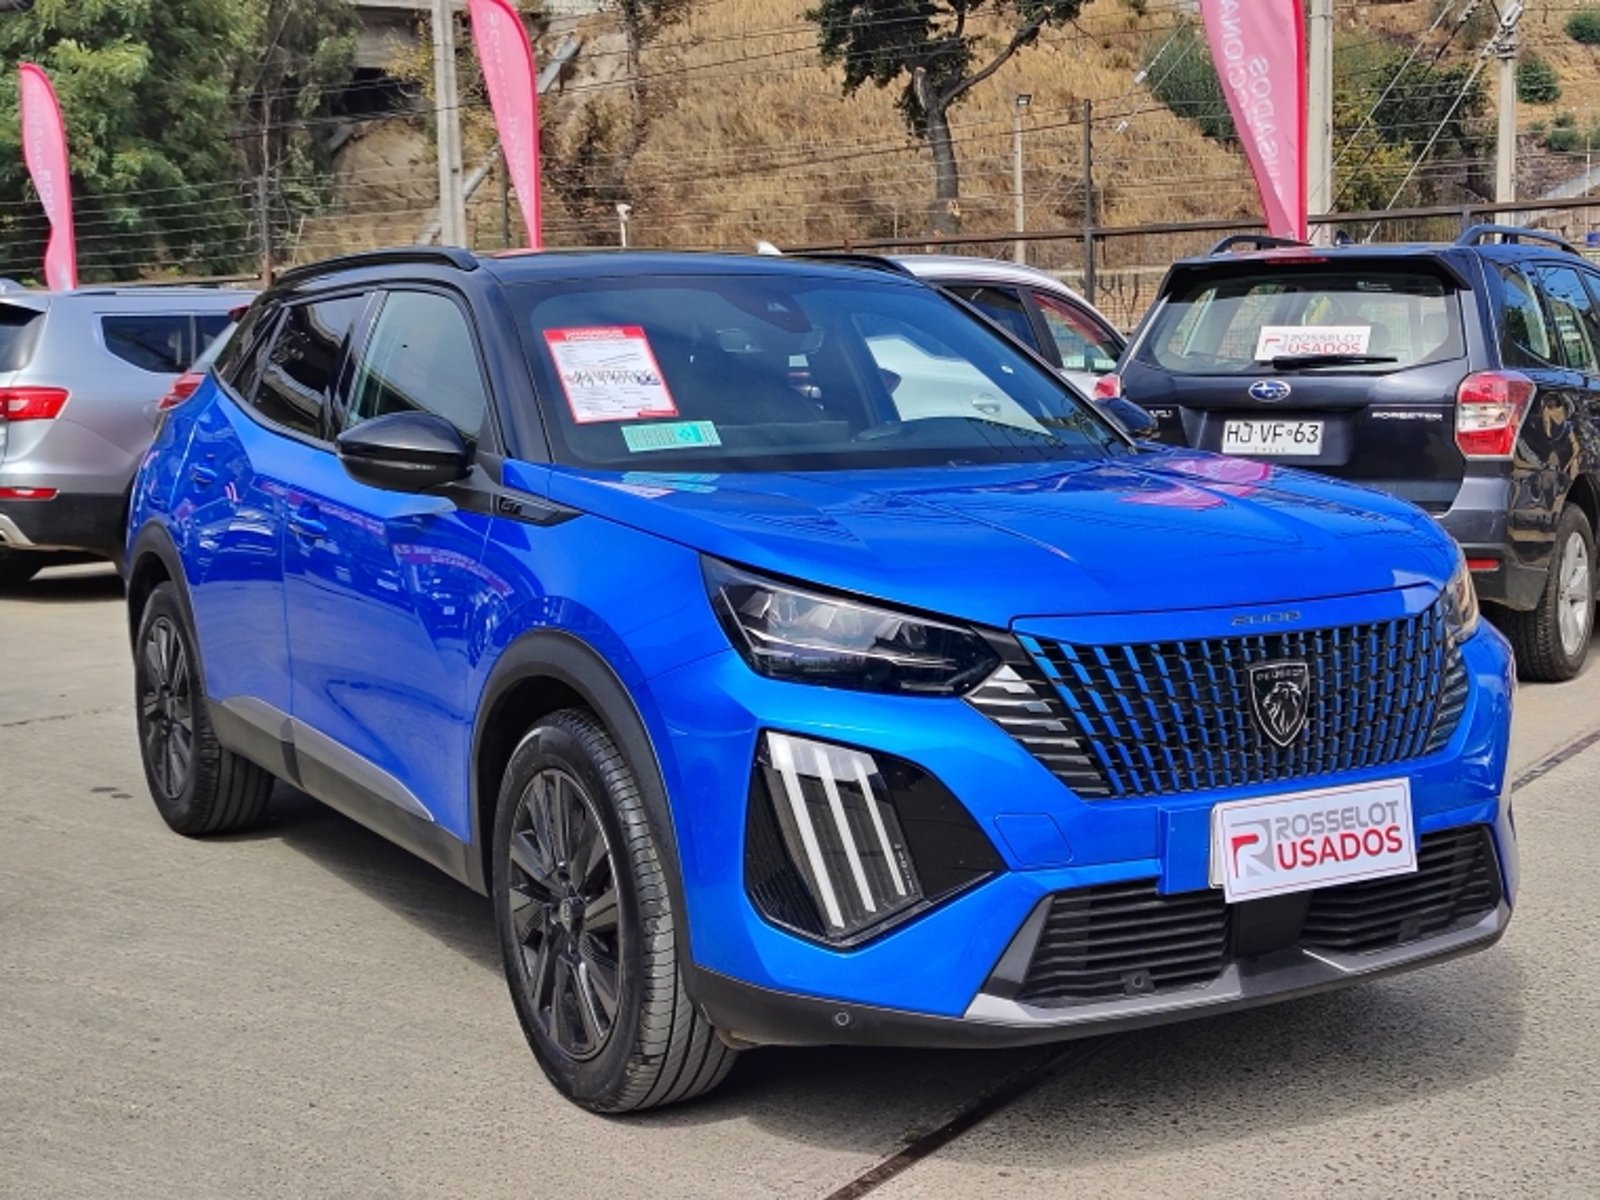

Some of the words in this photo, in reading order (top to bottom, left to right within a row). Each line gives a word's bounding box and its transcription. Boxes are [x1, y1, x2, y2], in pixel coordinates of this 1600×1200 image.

[1288, 342, 1362, 354] USADOS
[1275, 800, 1399, 840] ROSSELOT
[1277, 825, 1403, 871] USADOS
